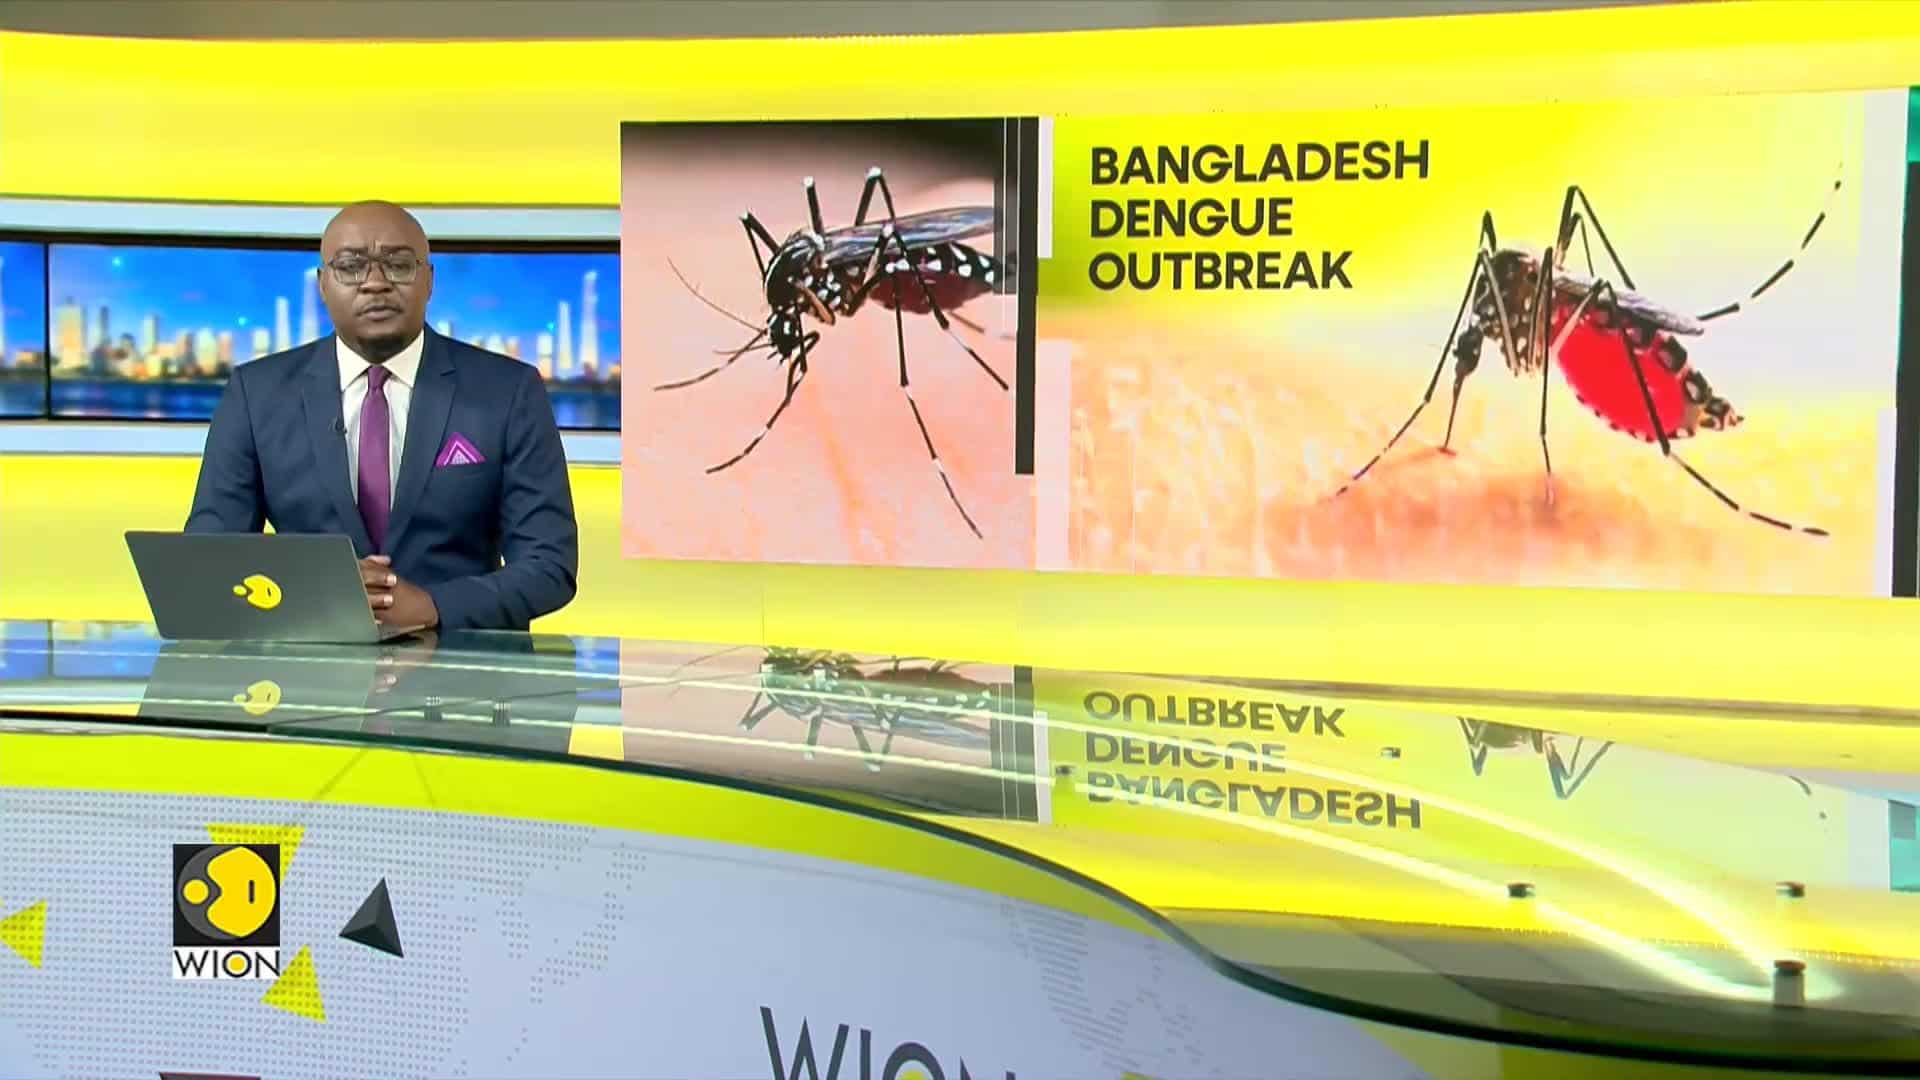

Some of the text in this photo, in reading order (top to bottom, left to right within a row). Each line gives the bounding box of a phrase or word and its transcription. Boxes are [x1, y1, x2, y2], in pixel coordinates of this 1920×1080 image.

[1090, 140, 1430, 185] BANGLADESH
[1090, 197, 1294, 238] DENGUE
[1088, 250, 1354, 291] OUTBREAK
